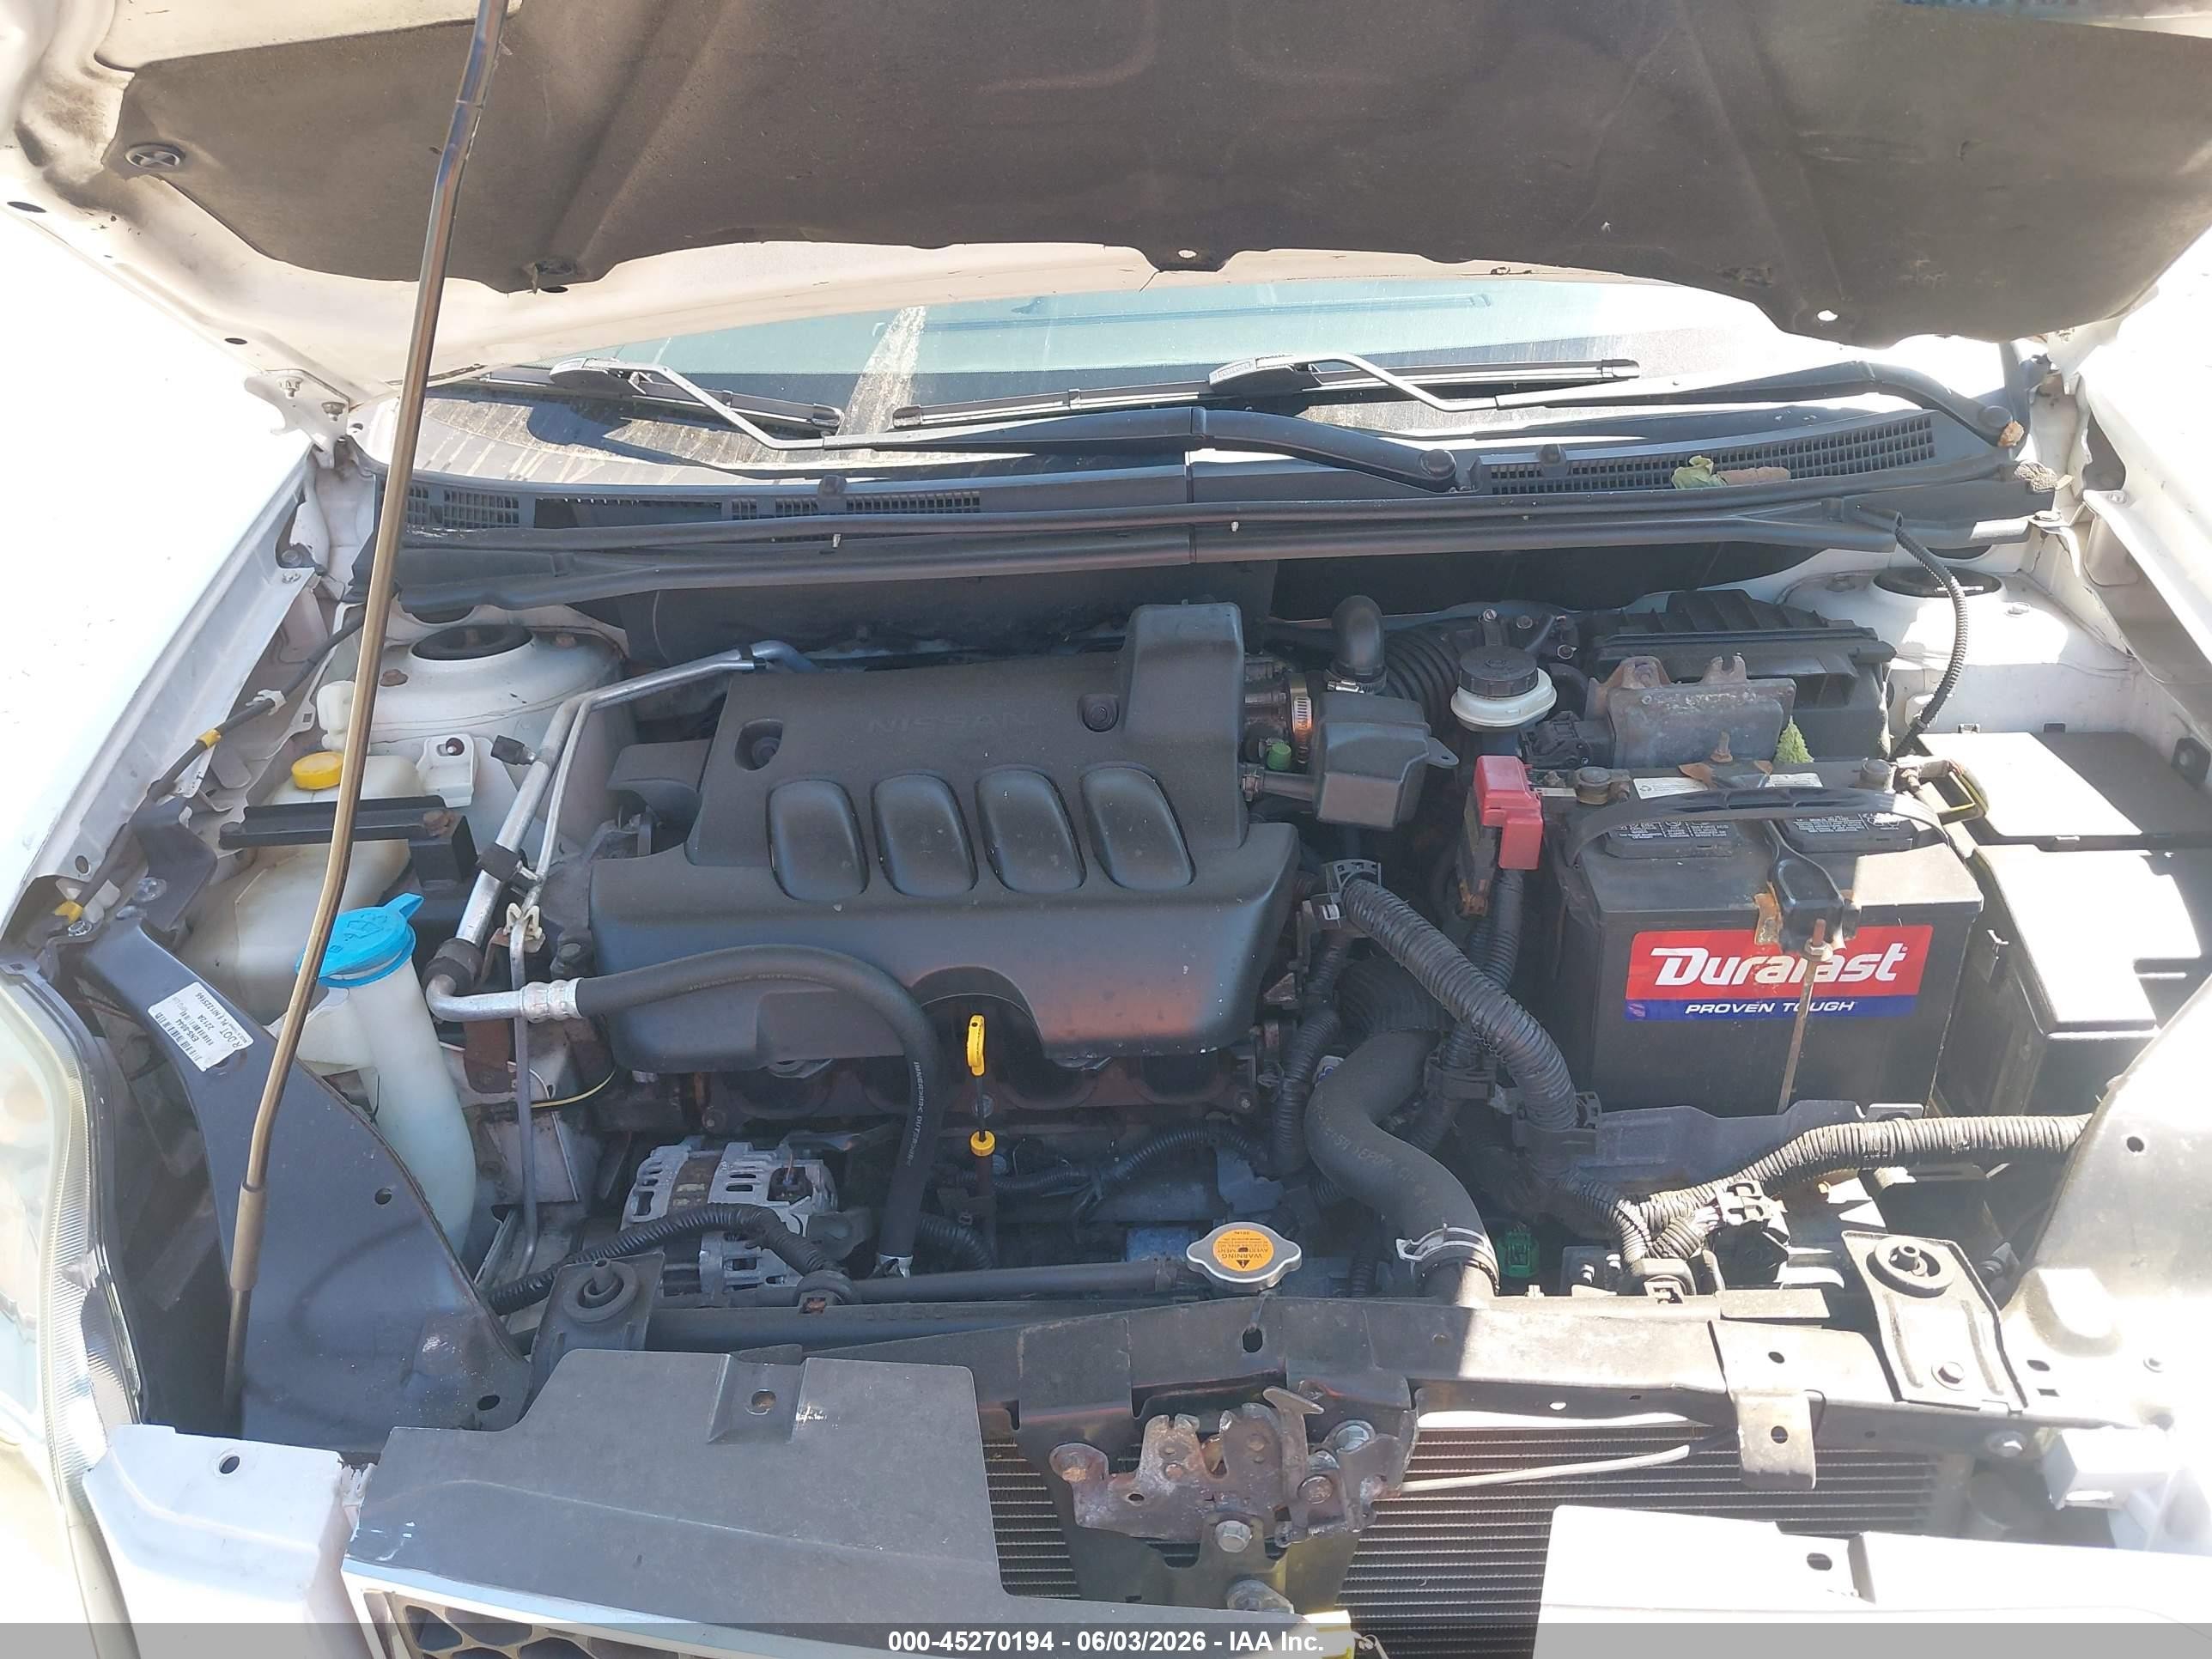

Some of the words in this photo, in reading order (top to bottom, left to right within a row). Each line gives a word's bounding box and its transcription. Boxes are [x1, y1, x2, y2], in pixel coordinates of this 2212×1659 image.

[869, 713, 1030, 732] NISSAN
[1685, 1002, 1775, 1014] PROVEN
[219, 1027, 238, 1042] DOT
